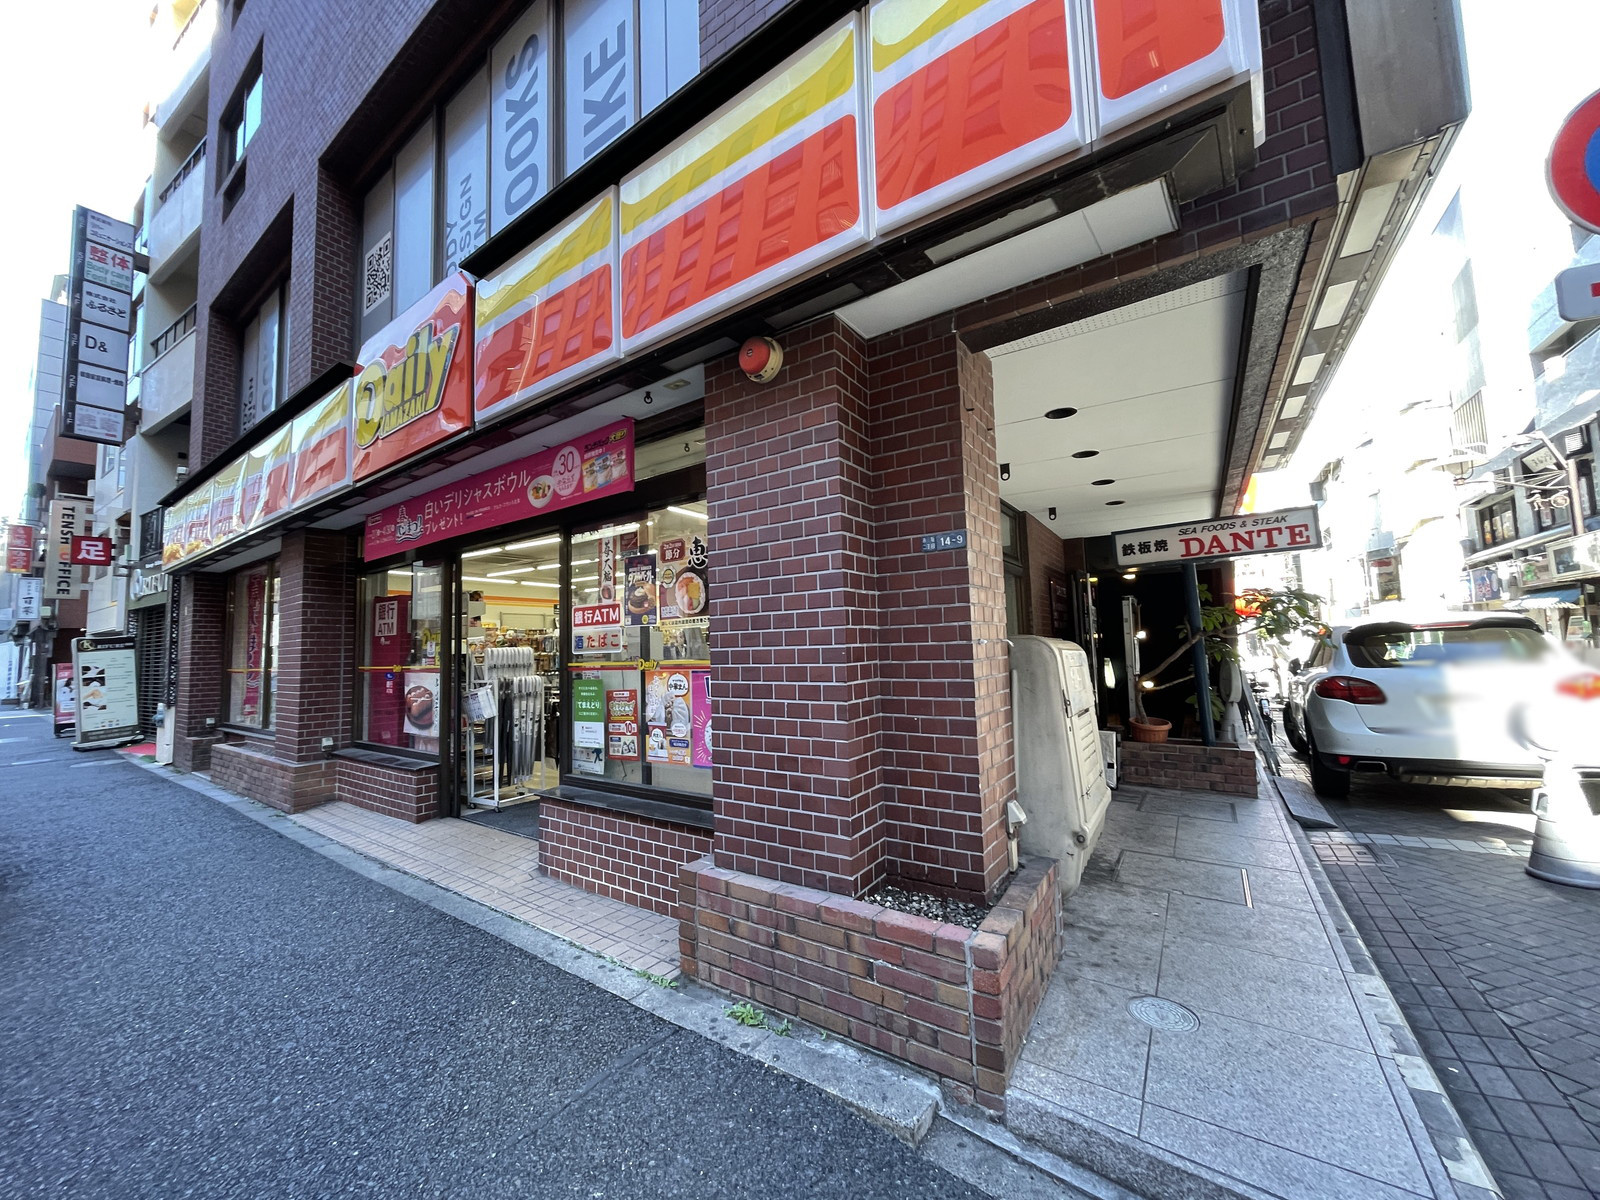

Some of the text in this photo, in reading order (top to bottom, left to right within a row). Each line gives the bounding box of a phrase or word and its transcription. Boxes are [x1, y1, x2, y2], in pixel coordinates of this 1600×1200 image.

[583, 19, 626, 160] IKE
[504, 33, 539, 216] OOKS
[89, 245, 131, 270] 整体
[86, 261, 131, 281] Body care
[85, 335, 108, 353] D&
[357, 323, 459, 447] Daily
[559, 451, 574, 475] 30
[424, 470, 531, 519] 白いデリシャスボウル
[1178, 514, 1288, 536] SEA FOODS & STEAK
[77, 540, 106, 561] 足
[940, 534, 963, 546] 14-9
[1121, 539, 1169, 557] 鉄板焼
[1178, 523, 1311, 558] DANTE
[574, 607, 619, 625] 銀行ATM
[377, 622, 394, 636] ATM
[586, 632, 620, 648] たばこ
